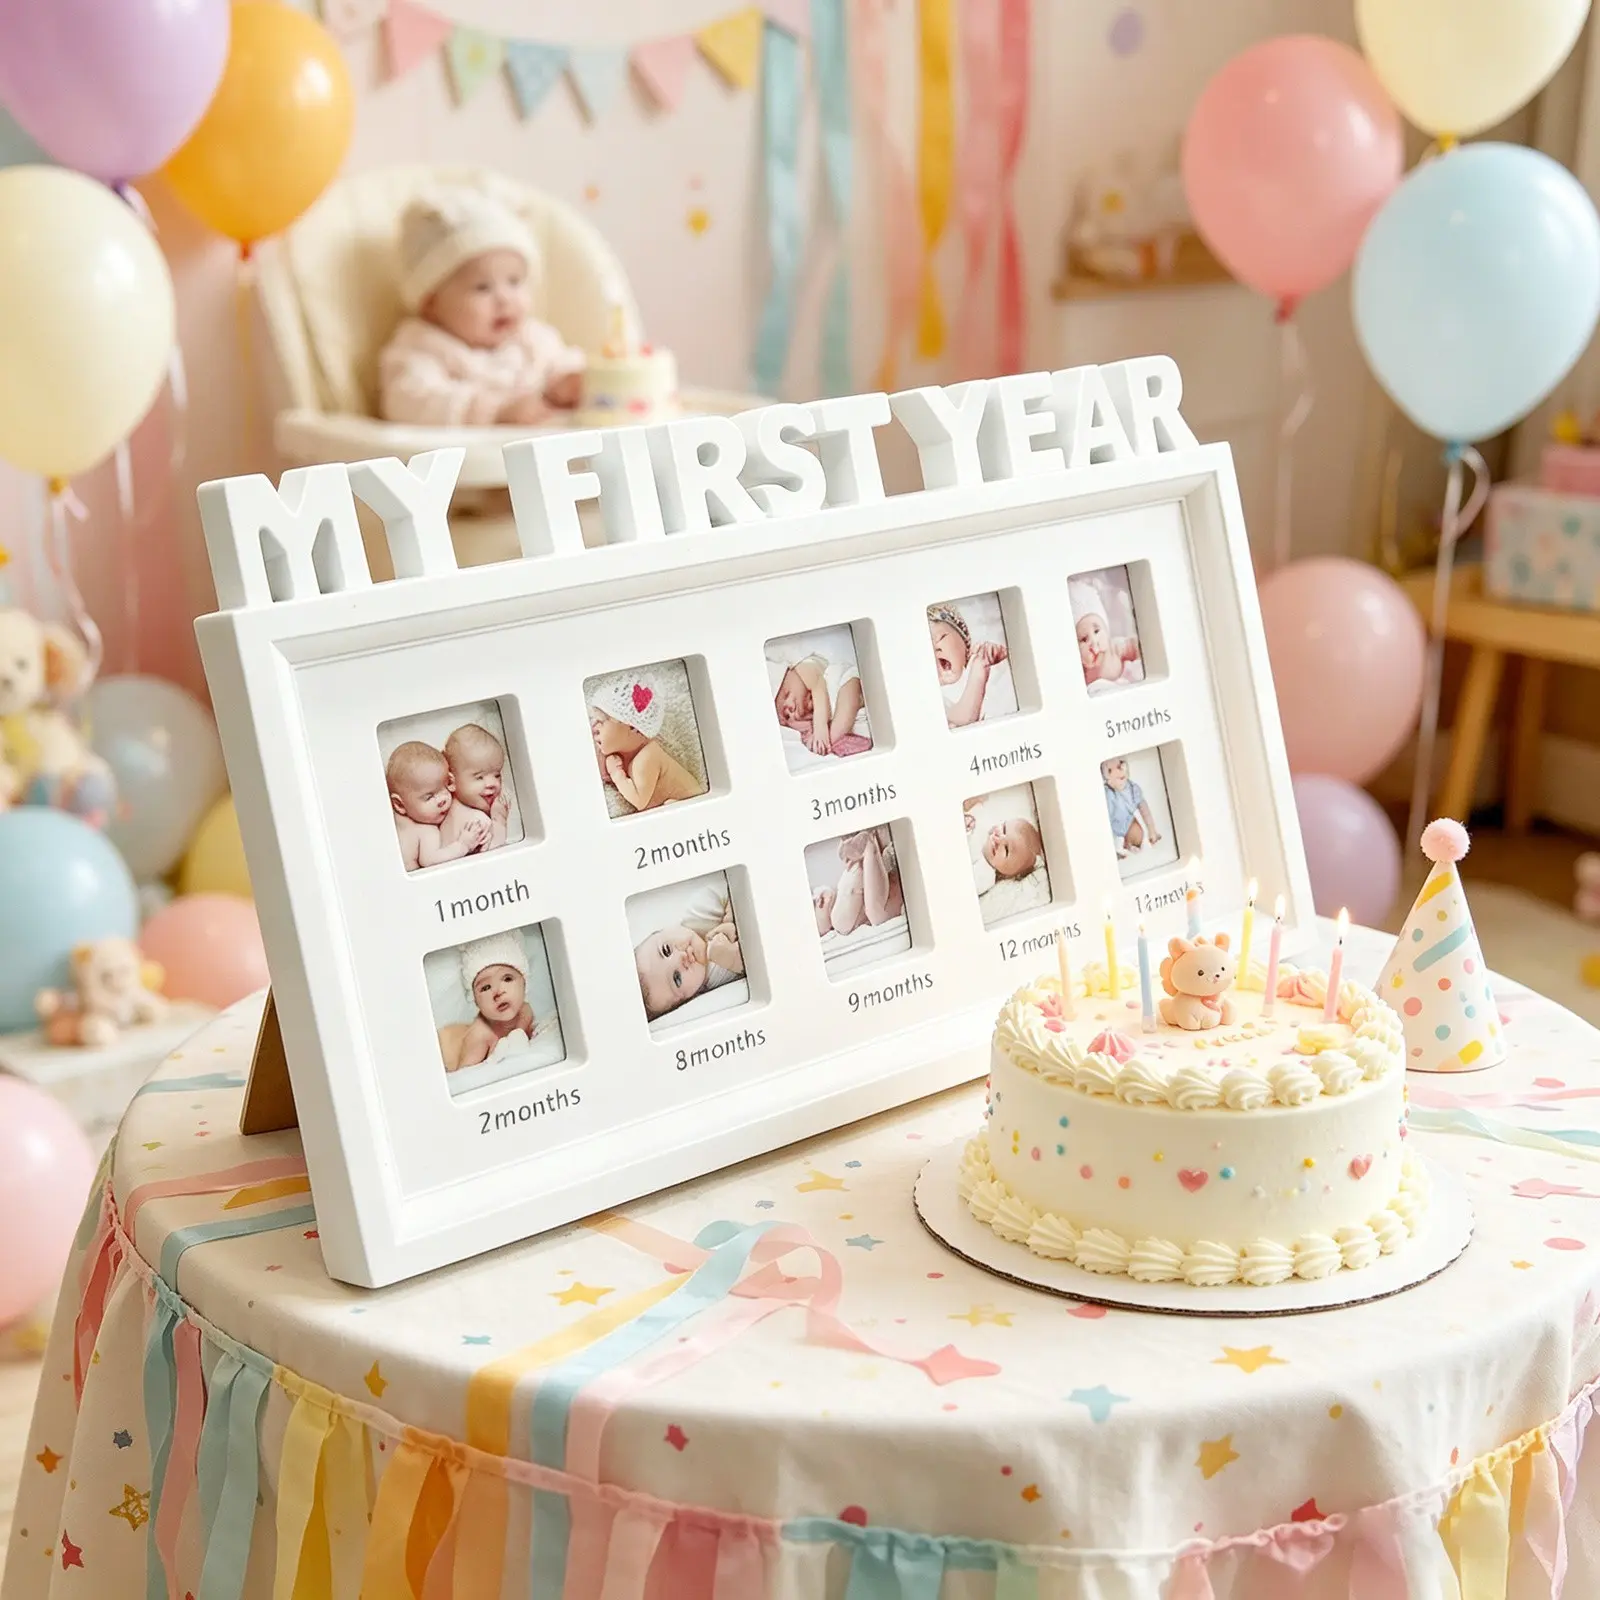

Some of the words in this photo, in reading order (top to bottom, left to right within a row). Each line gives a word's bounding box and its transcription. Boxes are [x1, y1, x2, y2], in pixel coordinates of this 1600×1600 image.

[197, 447, 467, 610] MY
[502, 392, 892, 558] FIRST
[889, 354, 1200, 493] YEAR
